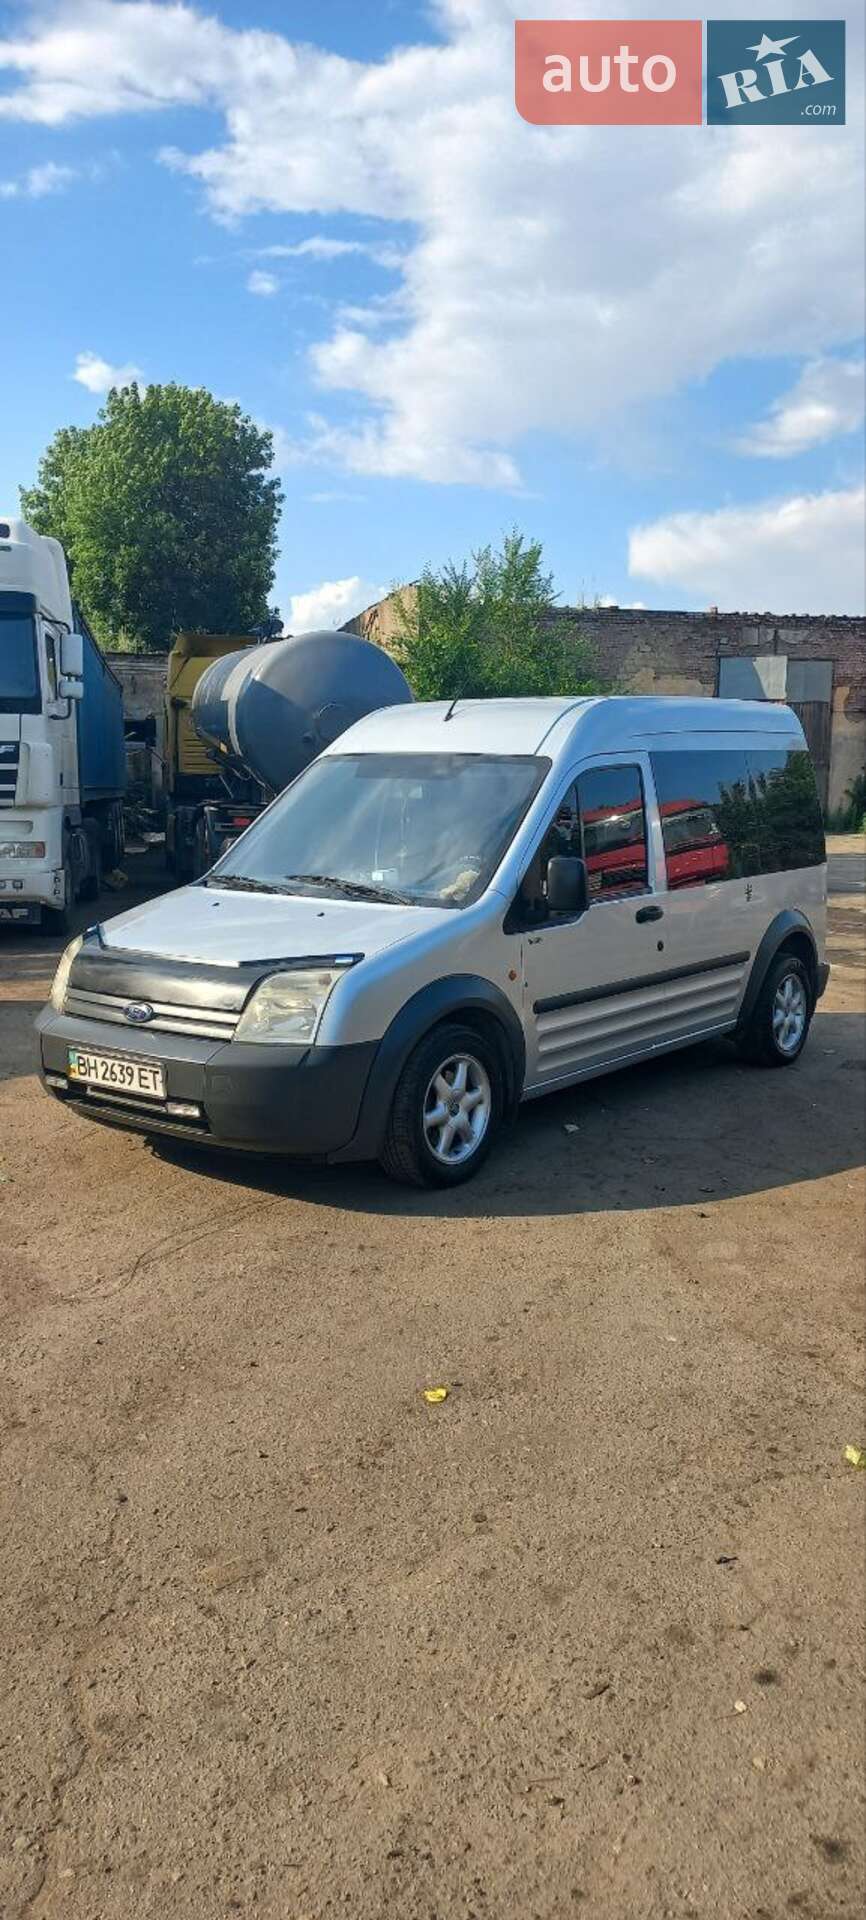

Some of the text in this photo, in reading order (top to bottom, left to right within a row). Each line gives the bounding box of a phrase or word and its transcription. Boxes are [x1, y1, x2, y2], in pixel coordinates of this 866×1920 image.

[78, 1055, 160, 1091] BH 2639 ET
